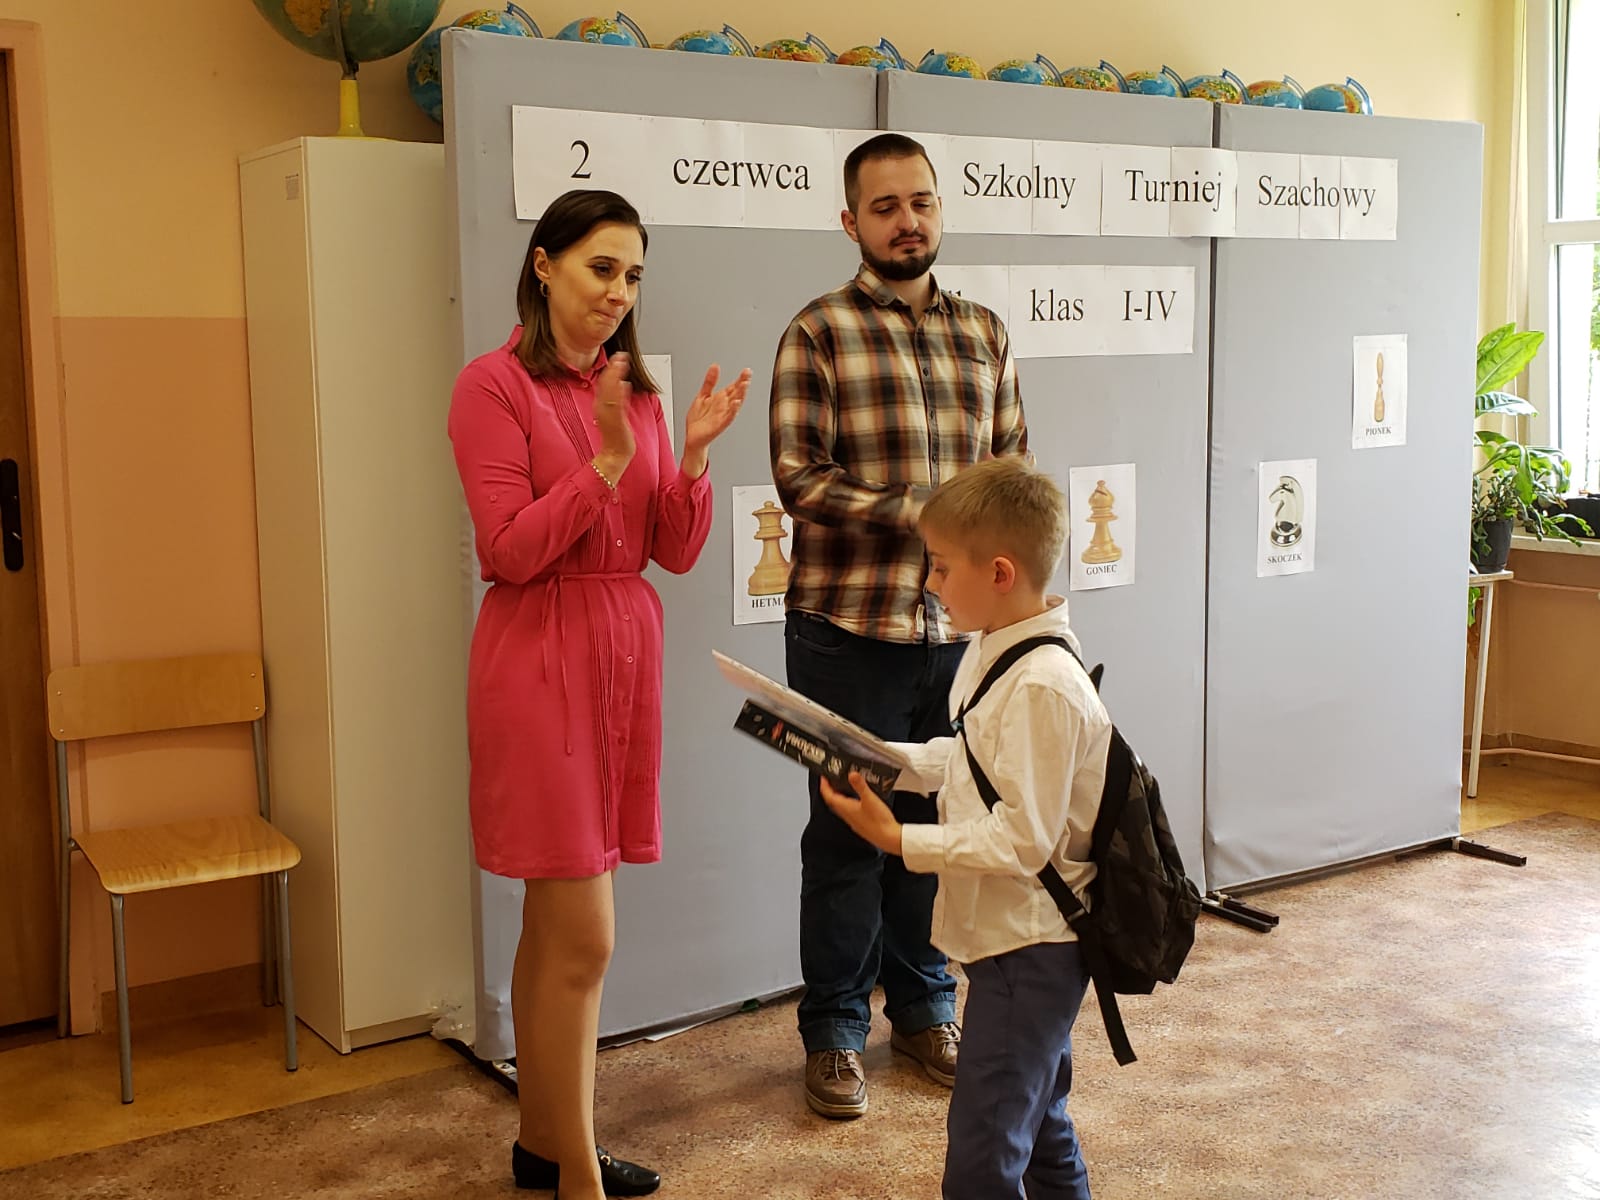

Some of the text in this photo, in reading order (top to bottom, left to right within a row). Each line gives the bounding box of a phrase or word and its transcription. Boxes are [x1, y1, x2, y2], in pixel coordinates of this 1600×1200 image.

[570, 139, 1376, 217] 2 czerwca Szkolny Turniej Szachowy
[1030, 288, 1177, 322] klas I-IV
[1365, 426, 1392, 436] PIONEK
[1266, 553, 1302, 564] SKOCZEK
[1086, 564, 1118, 575] GONIEC
[751, 597, 784, 608] HETM
